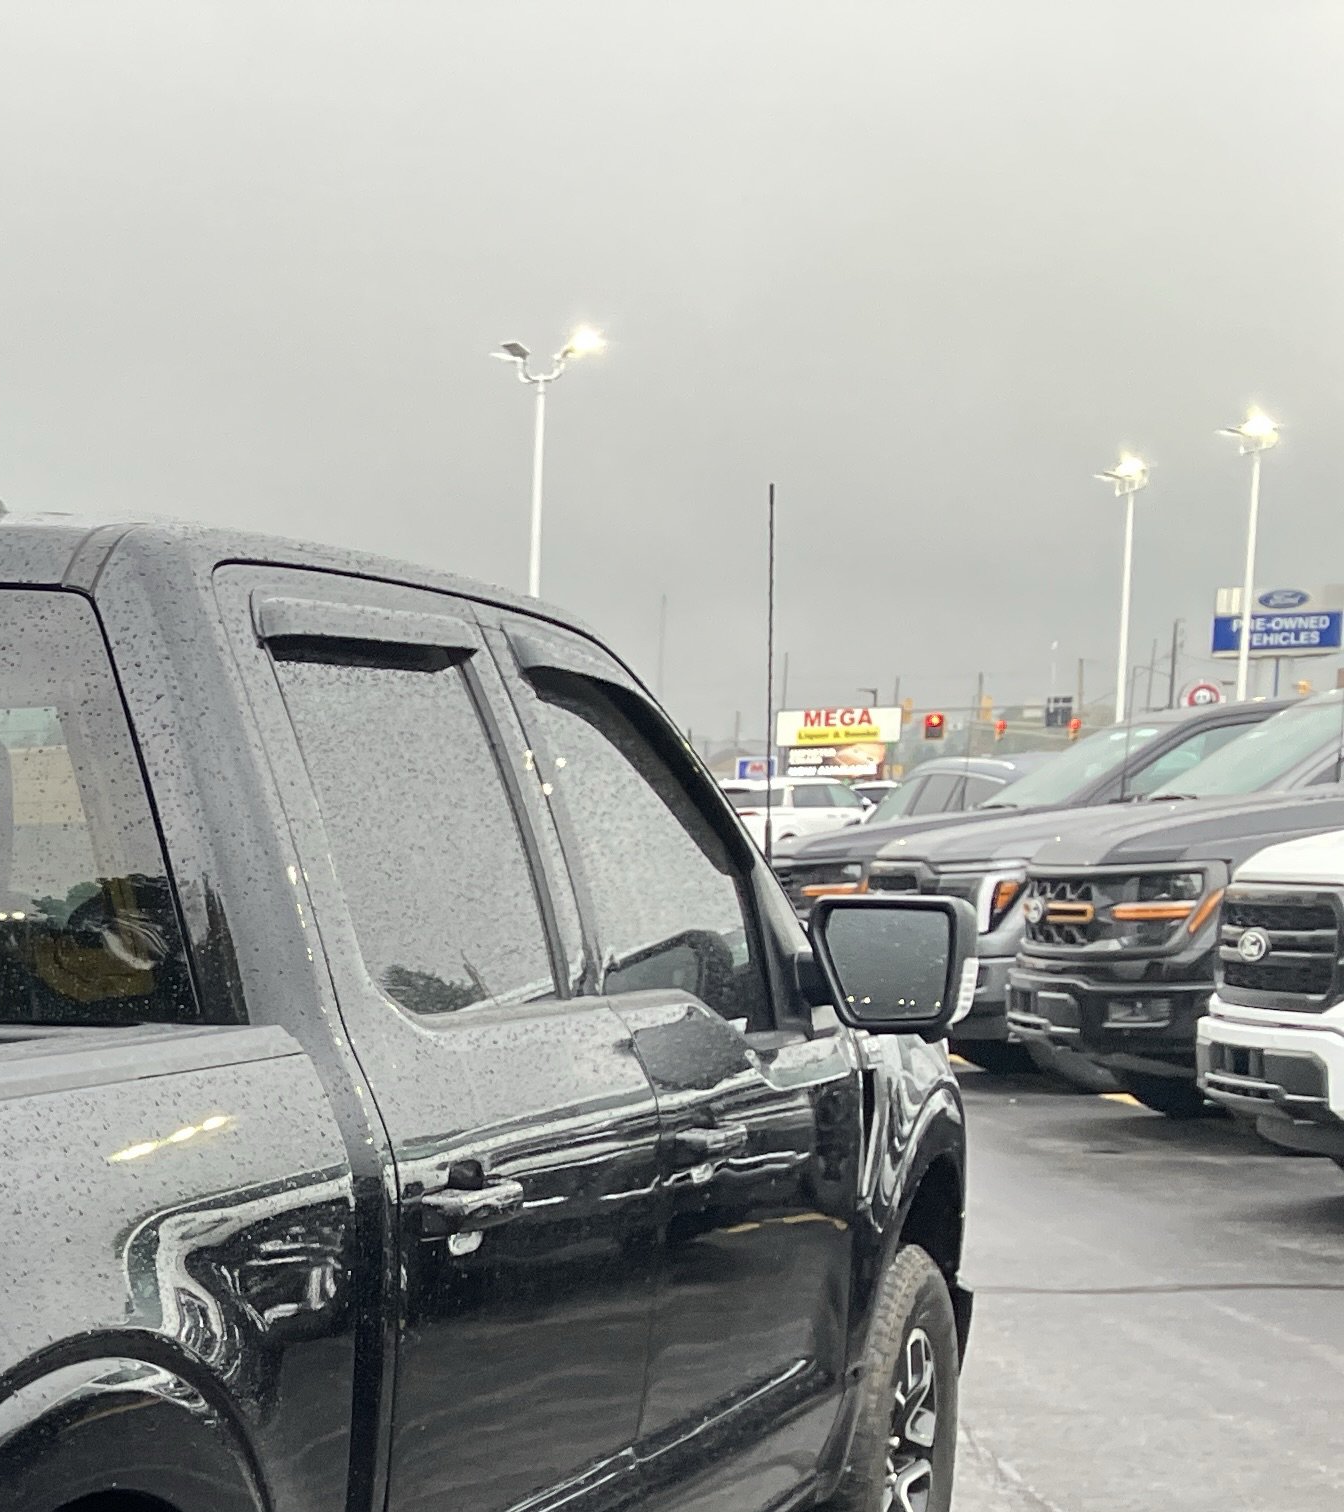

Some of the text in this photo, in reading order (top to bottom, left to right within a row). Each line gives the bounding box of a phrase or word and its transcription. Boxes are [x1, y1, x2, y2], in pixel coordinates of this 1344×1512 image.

[1231, 615, 1330, 633] PE-OWNED
[1248, 631, 1321, 647] EHICLES
[803, 708, 873, 727] MEGA
